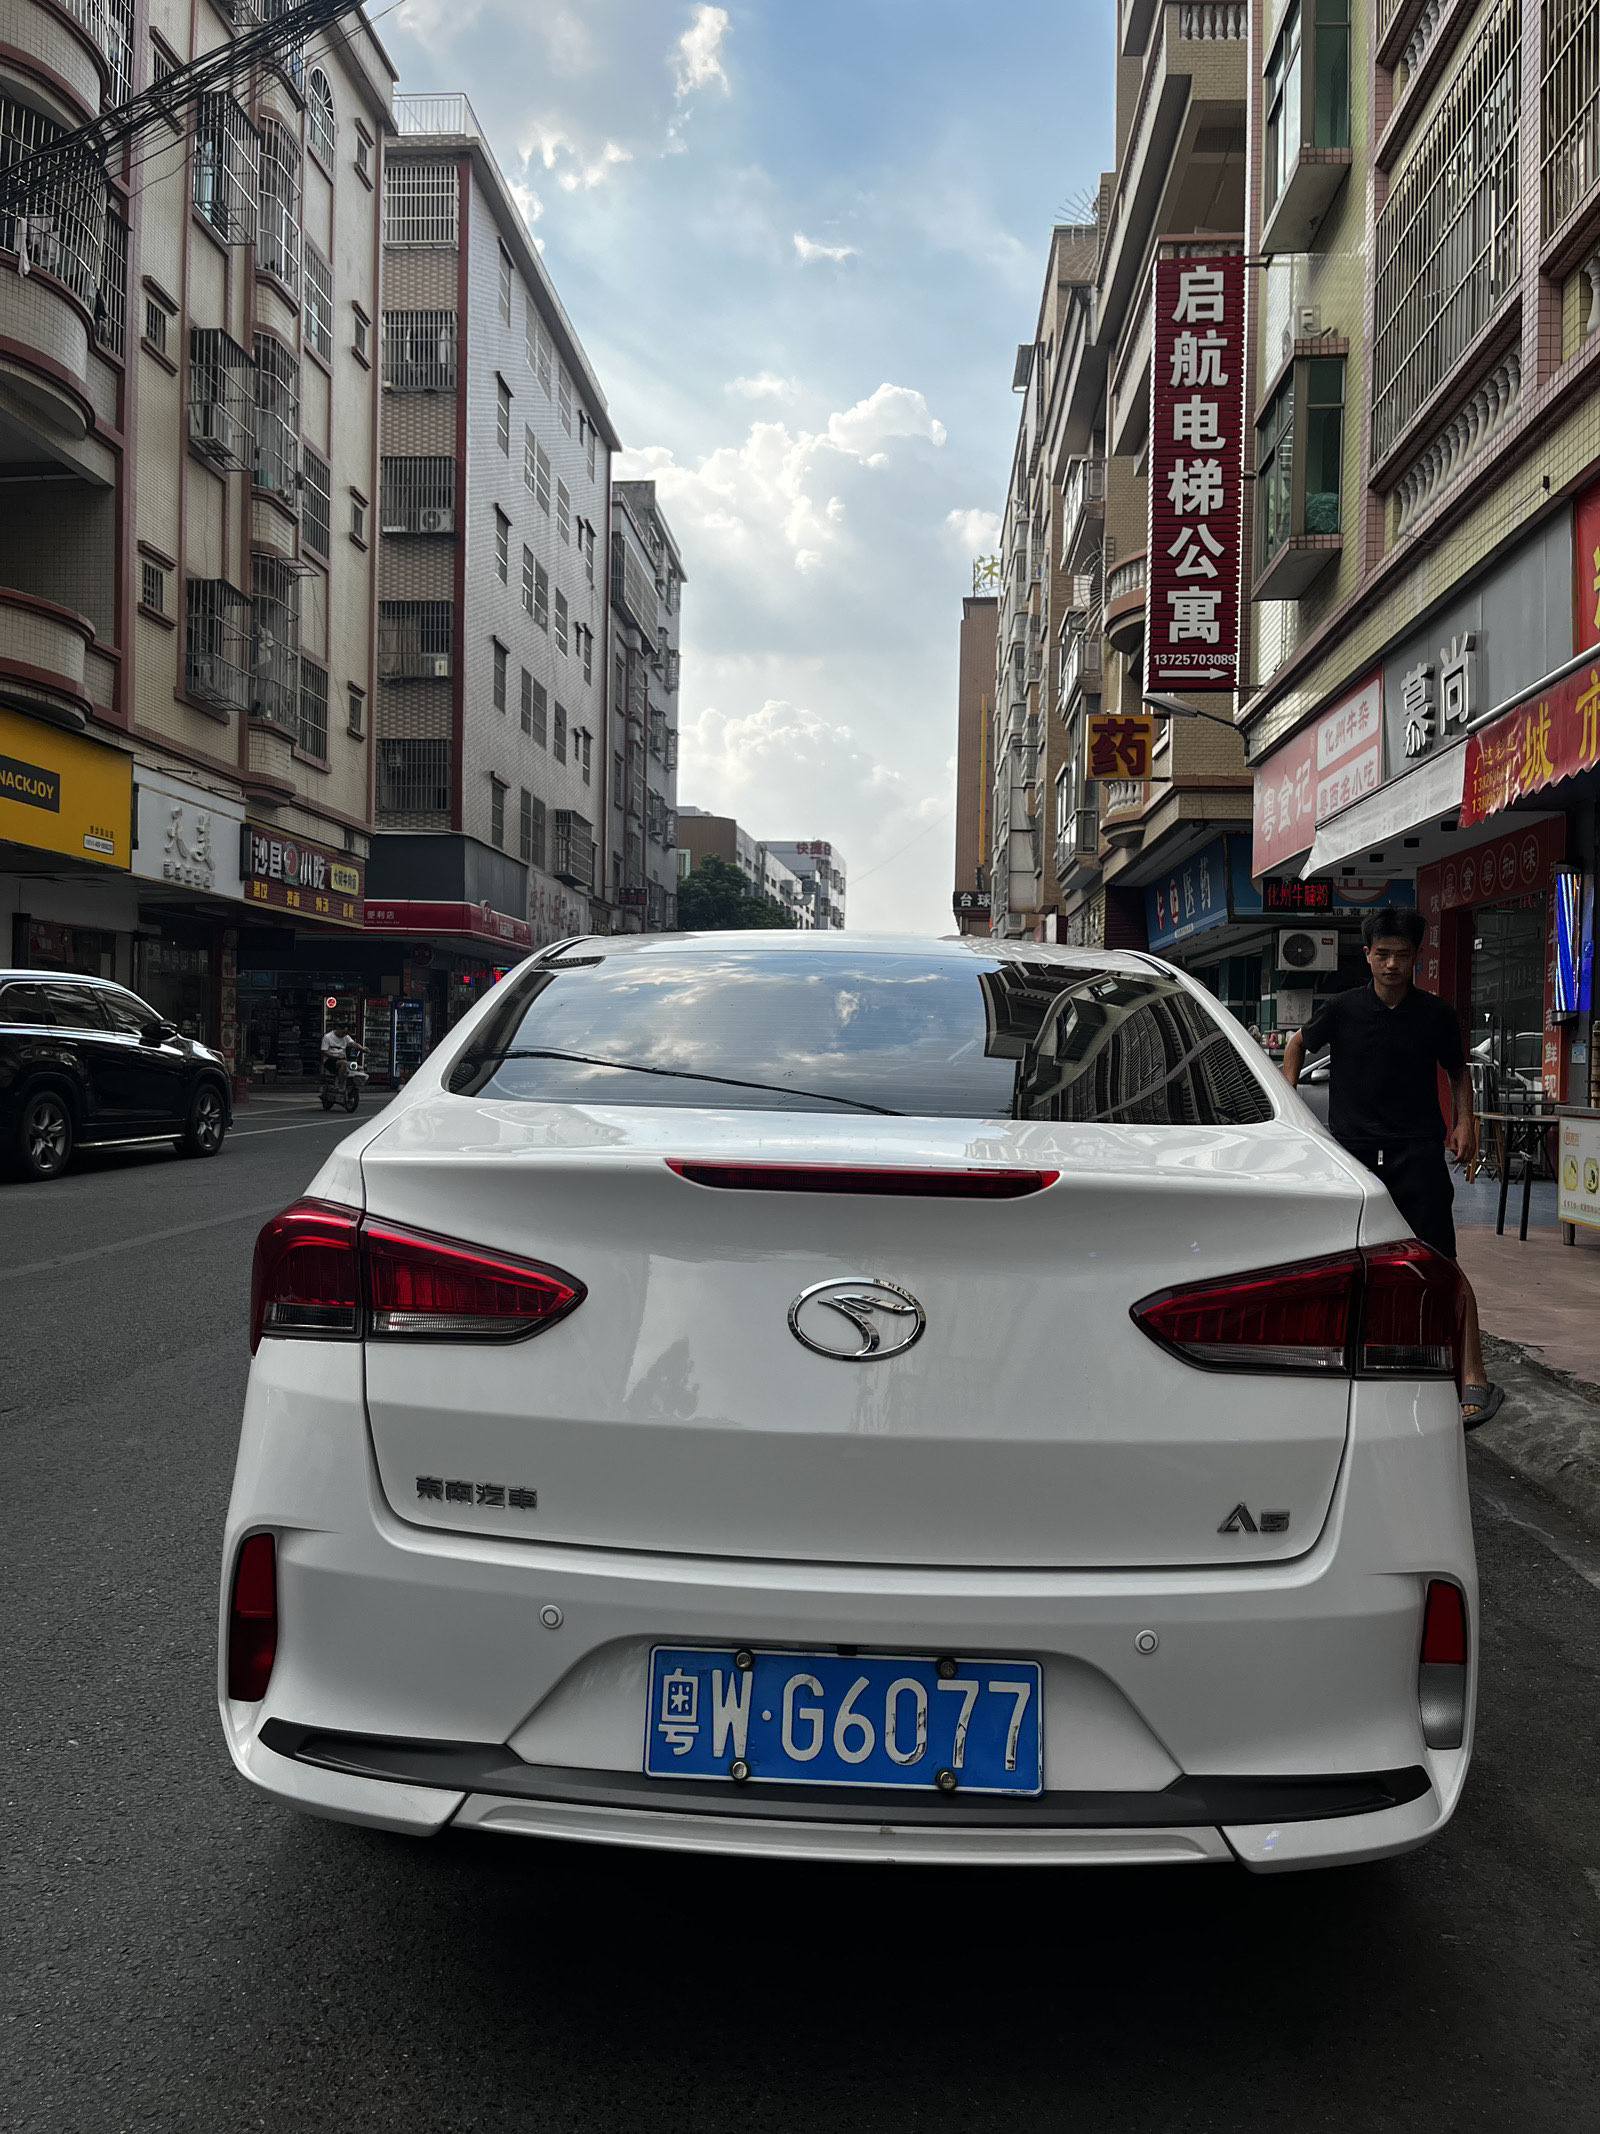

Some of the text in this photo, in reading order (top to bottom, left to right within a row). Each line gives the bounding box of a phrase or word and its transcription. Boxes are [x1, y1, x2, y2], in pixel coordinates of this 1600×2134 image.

[1167, 265, 1229, 643] 启航电梯公寓
[1153, 653, 1235, 666] 13725703089
[1401, 631, 1475, 757] 慕尚
[1091, 718, 1149, 776] 药
[1325, 700, 1370, 755] 化州牛杂
[1319, 759, 1375, 818] 粤西名小吃
[252, 836, 283, 879] 沙县
[300, 852, 326, 890] 小吃
[367, 910, 395, 920] 便利店
[960, 893, 991, 908] 台球
[1267, 883, 1329, 908] 化州牛腩粉
[1428, 895, 1440, 996] 味道的
[416, 1475, 537, 1511] 東南汽車
[1217, 1502, 1290, 1533] A5
[658, 1668, 1031, 1771] 粤W·G6077
